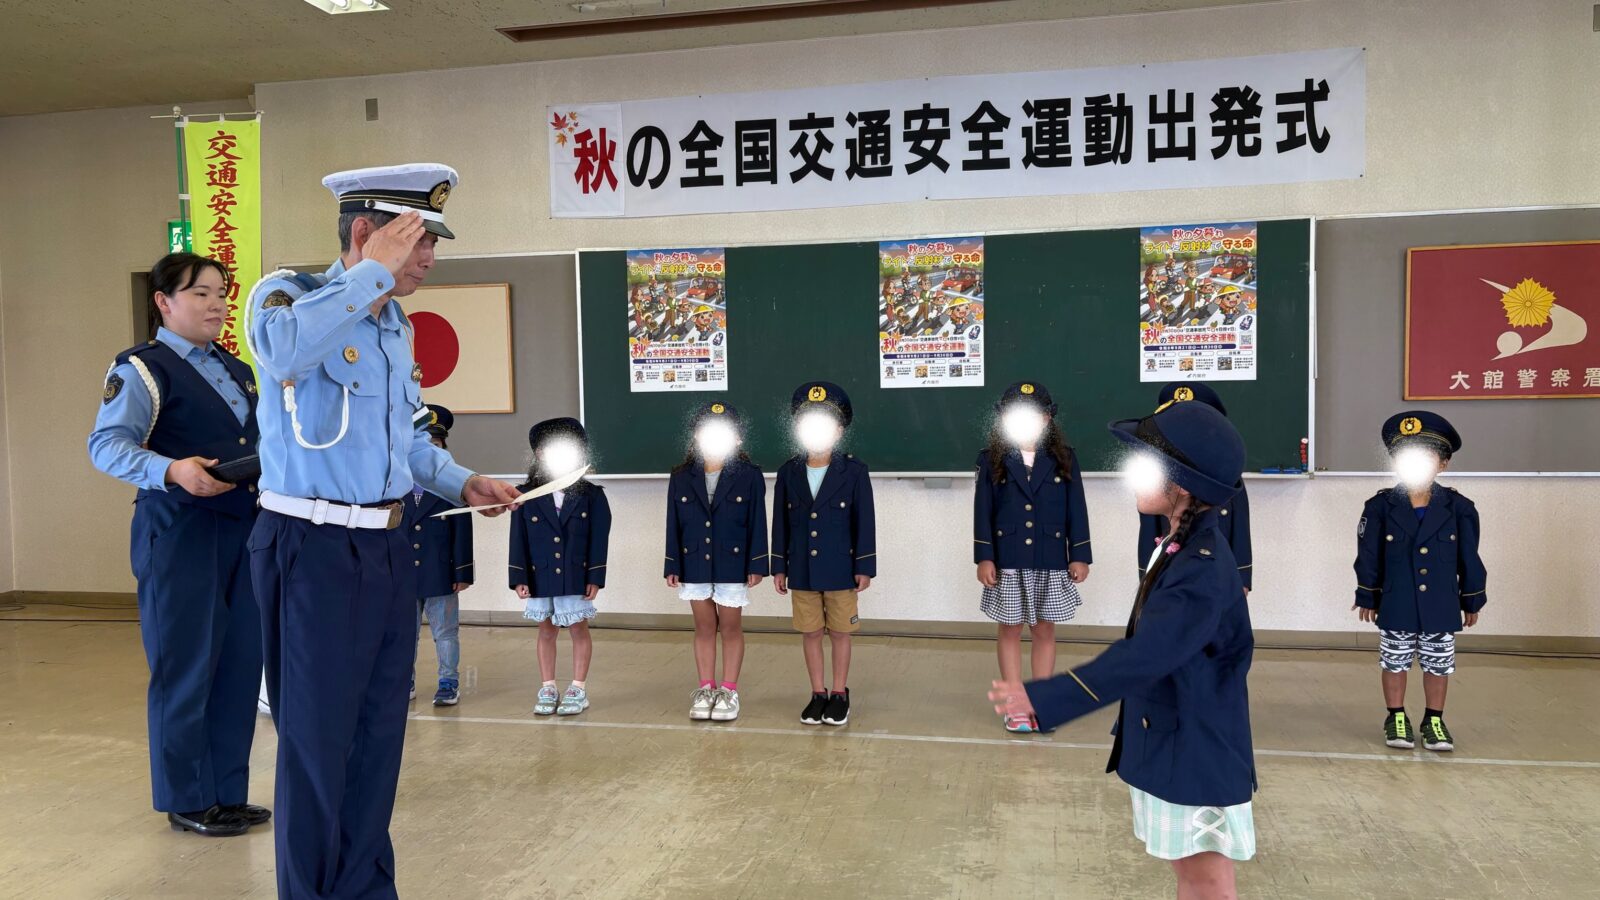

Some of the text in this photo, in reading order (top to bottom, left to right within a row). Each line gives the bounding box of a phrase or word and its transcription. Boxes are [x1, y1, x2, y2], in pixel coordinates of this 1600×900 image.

[573, 78, 1331, 195] 秋の全国交通安全運動出発式
[1173, 228, 1223, 239] 秋の夕暮れ
[1143, 328, 1236, 344] 秋の全国交通安全運動
[1449, 368, 1600, 390] 大館警察署
